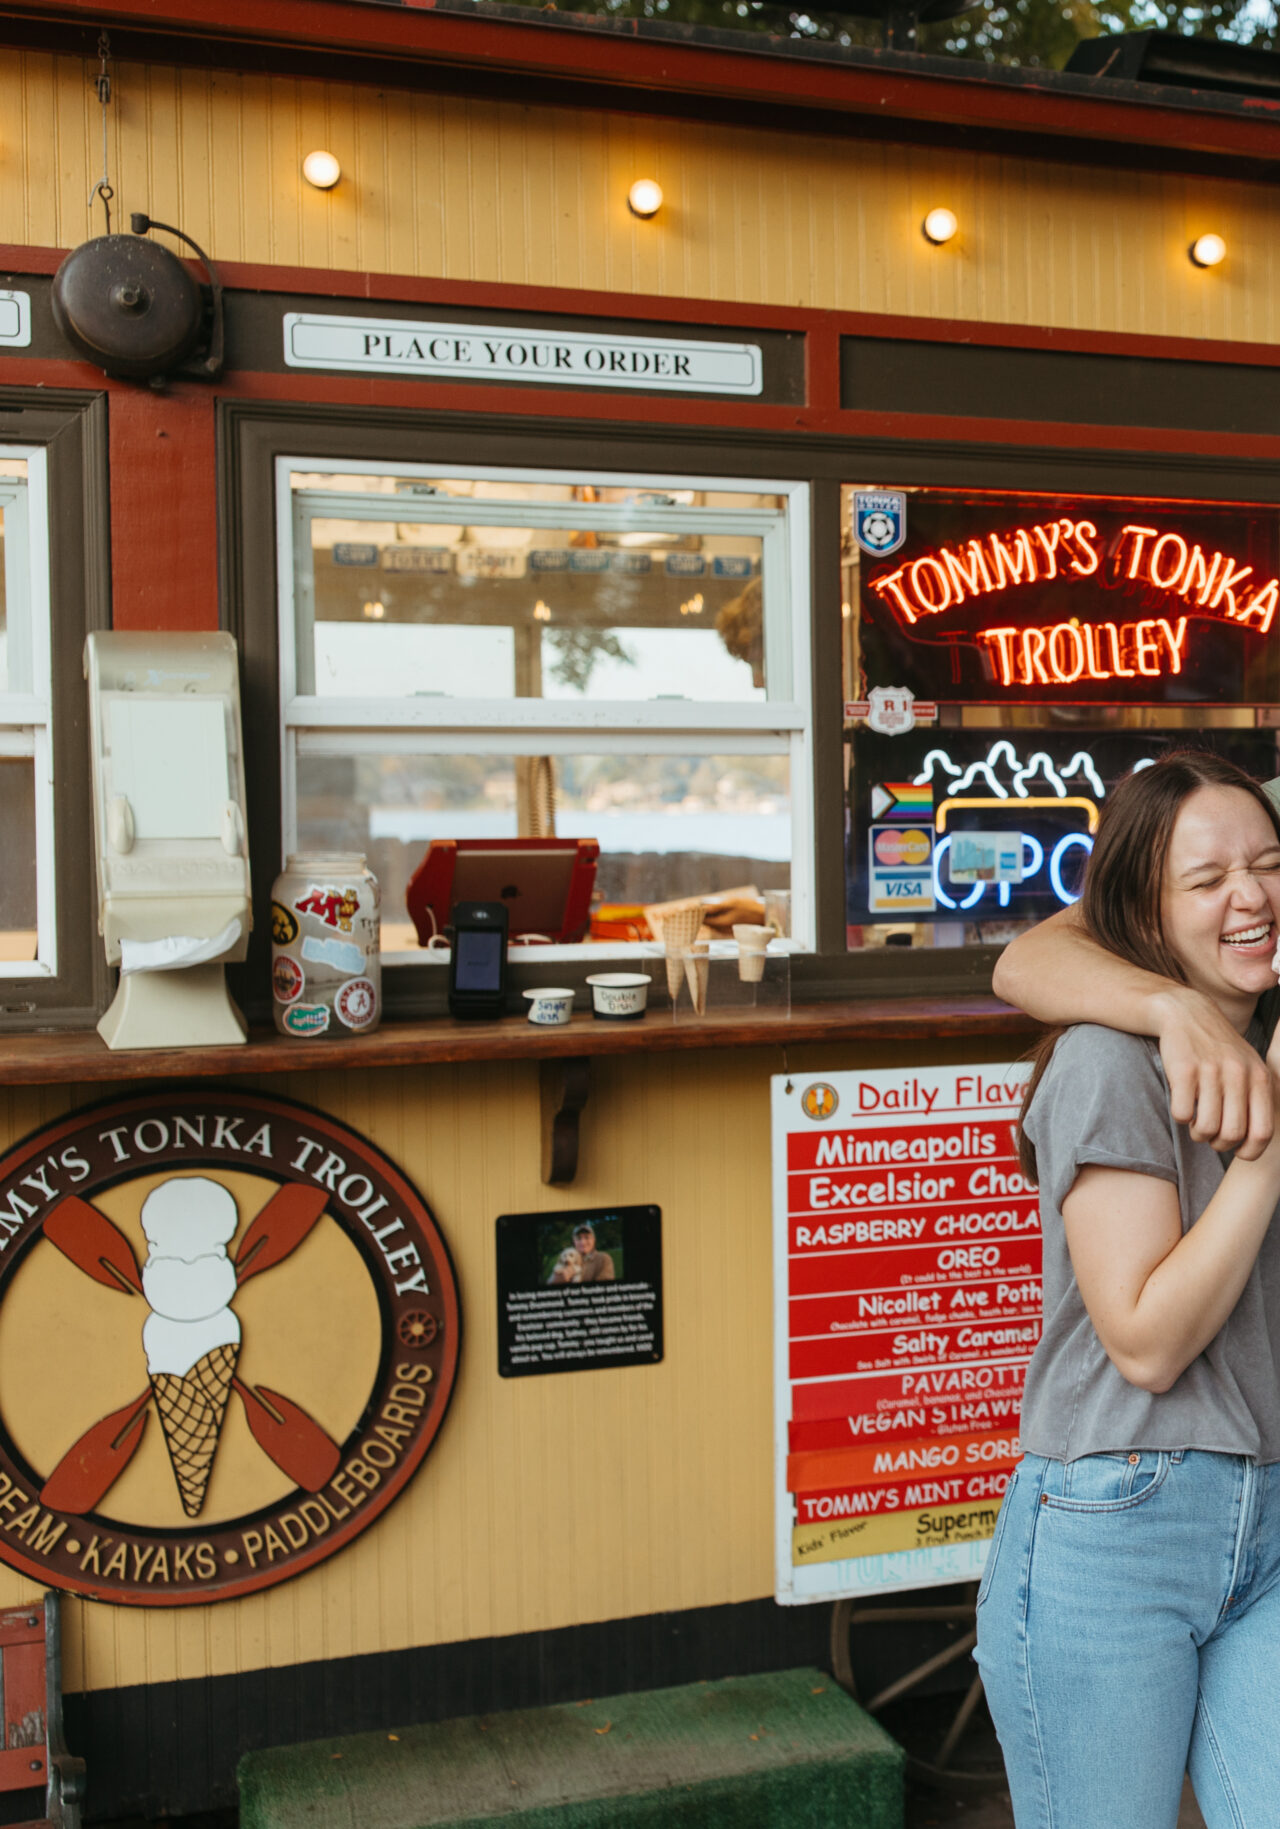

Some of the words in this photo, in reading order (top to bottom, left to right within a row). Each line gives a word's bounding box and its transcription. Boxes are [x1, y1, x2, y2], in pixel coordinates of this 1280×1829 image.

[362, 334, 472, 363] PLACE
[483, 341, 573, 369] YOUR
[584, 347, 692, 377] ORDER
[873, 518, 1098, 624] TOMMY'S
[1122, 524, 1280, 634] TONKA
[984, 617, 1188, 687] TROLLEY
[876, 840, 930, 853] MasterCard
[885, 882, 923, 897] VISA
[538, 1001, 567, 1012] Single
[600, 990, 637, 1001] Double
[858, 1078, 939, 1116] Daily
[815, 1126, 998, 1168] Minneapolis
[0, 1145, 91, 1252] MY'S
[99, 1114, 275, 1165] TONKA
[288, 1136, 431, 1298] TROLLEY
[810, 1172, 955, 1208] Excelsior
[796, 1216, 927, 1248] RASPBERRY
[934, 1209, 1041, 1237] CHOCOLA
[937, 1246, 1000, 1270] OREO
[858, 1291, 942, 1318] Nicollet
[950, 1288, 990, 1309] Ave
[892, 1330, 950, 1355] Salty
[957, 1321, 1039, 1348] Caramel
[965, 1389, 983, 1400] and
[848, 1408, 927, 1435] VEGAN
[937, 1423, 969, 1435] Gluten
[970, 1420, 993, 1432] Free
[79, 1534, 218, 1584] KAYAKS
[241, 1362, 434, 1568] PADDLEBOARDS
[873, 1445, 960, 1474] MANGO
[802, 1488, 900, 1519] TOMMY'S
[904, 1480, 964, 1506] MINT
[829, 1520, 868, 1542] Flavor
[916, 1508, 1001, 1538] Superm
